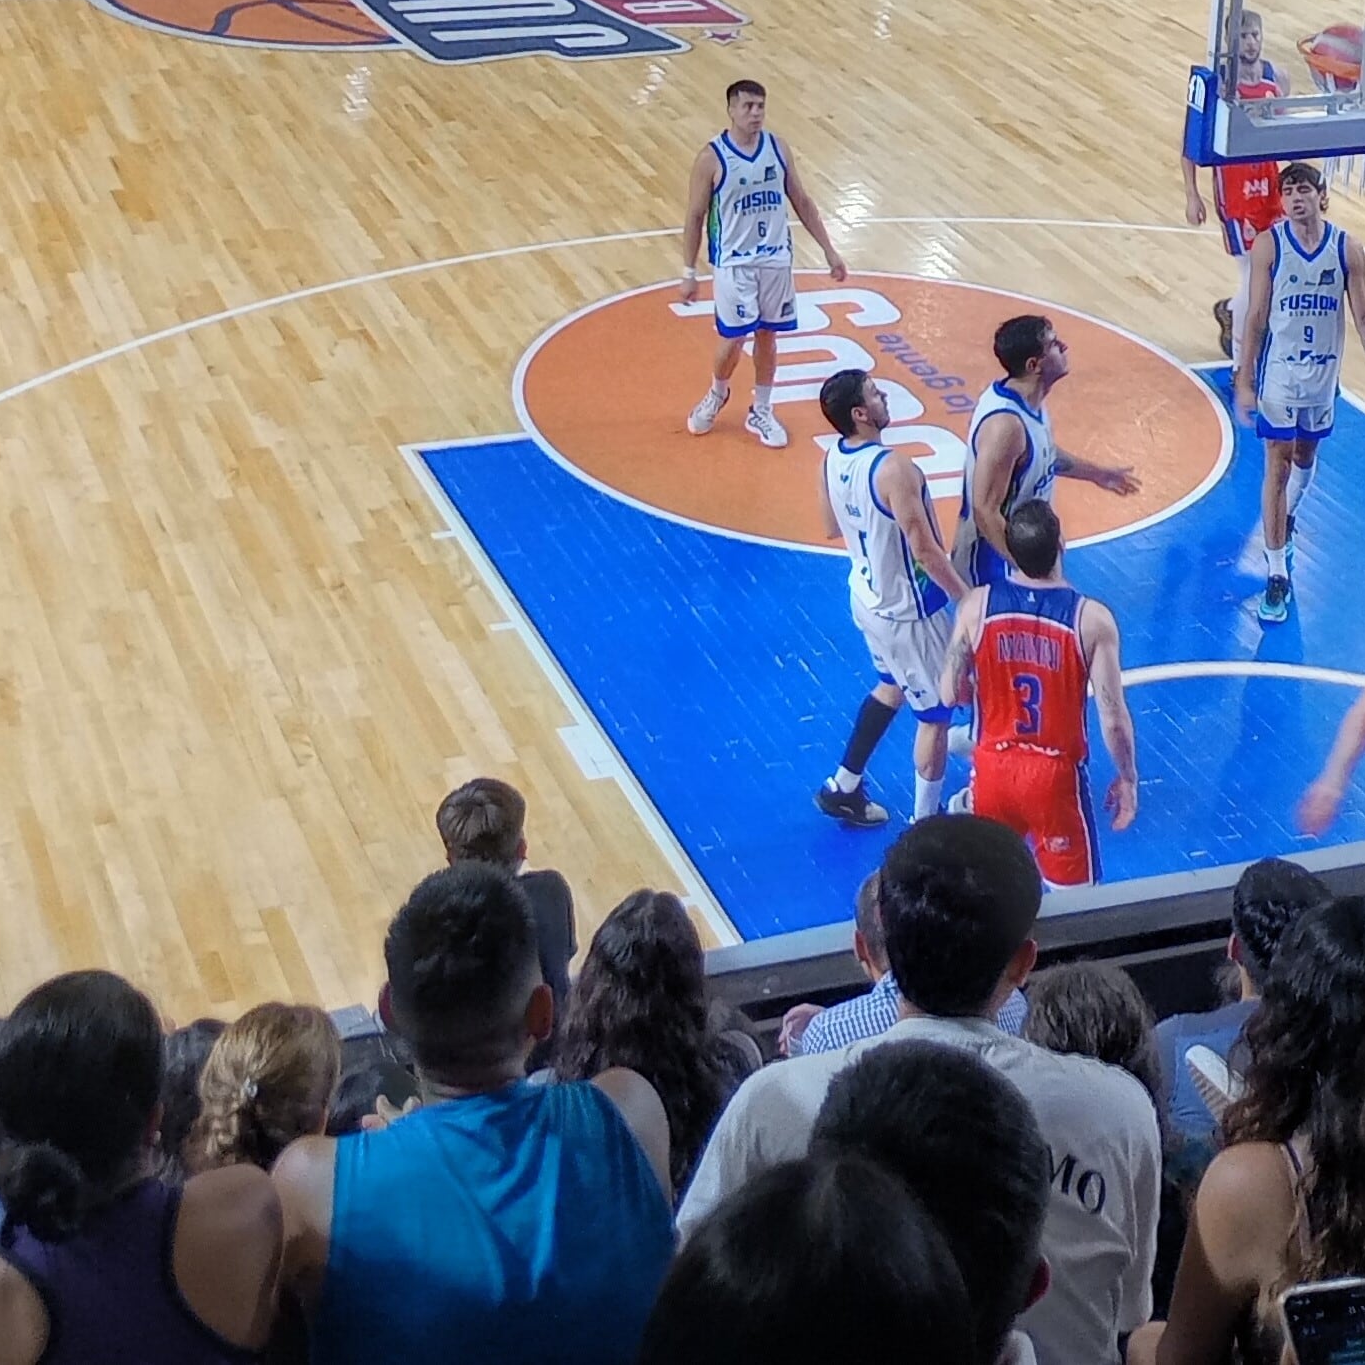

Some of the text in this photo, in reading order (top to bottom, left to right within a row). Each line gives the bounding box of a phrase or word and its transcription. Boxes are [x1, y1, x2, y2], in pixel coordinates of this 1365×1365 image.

[733, 190, 782, 215] FUSION
[757, 221, 767, 238] 6
[1279, 293, 1338, 312] FUSION
[1303, 326, 1314, 344] 9
[874, 330, 966, 391] gente
[1010, 673, 1043, 737] 3
